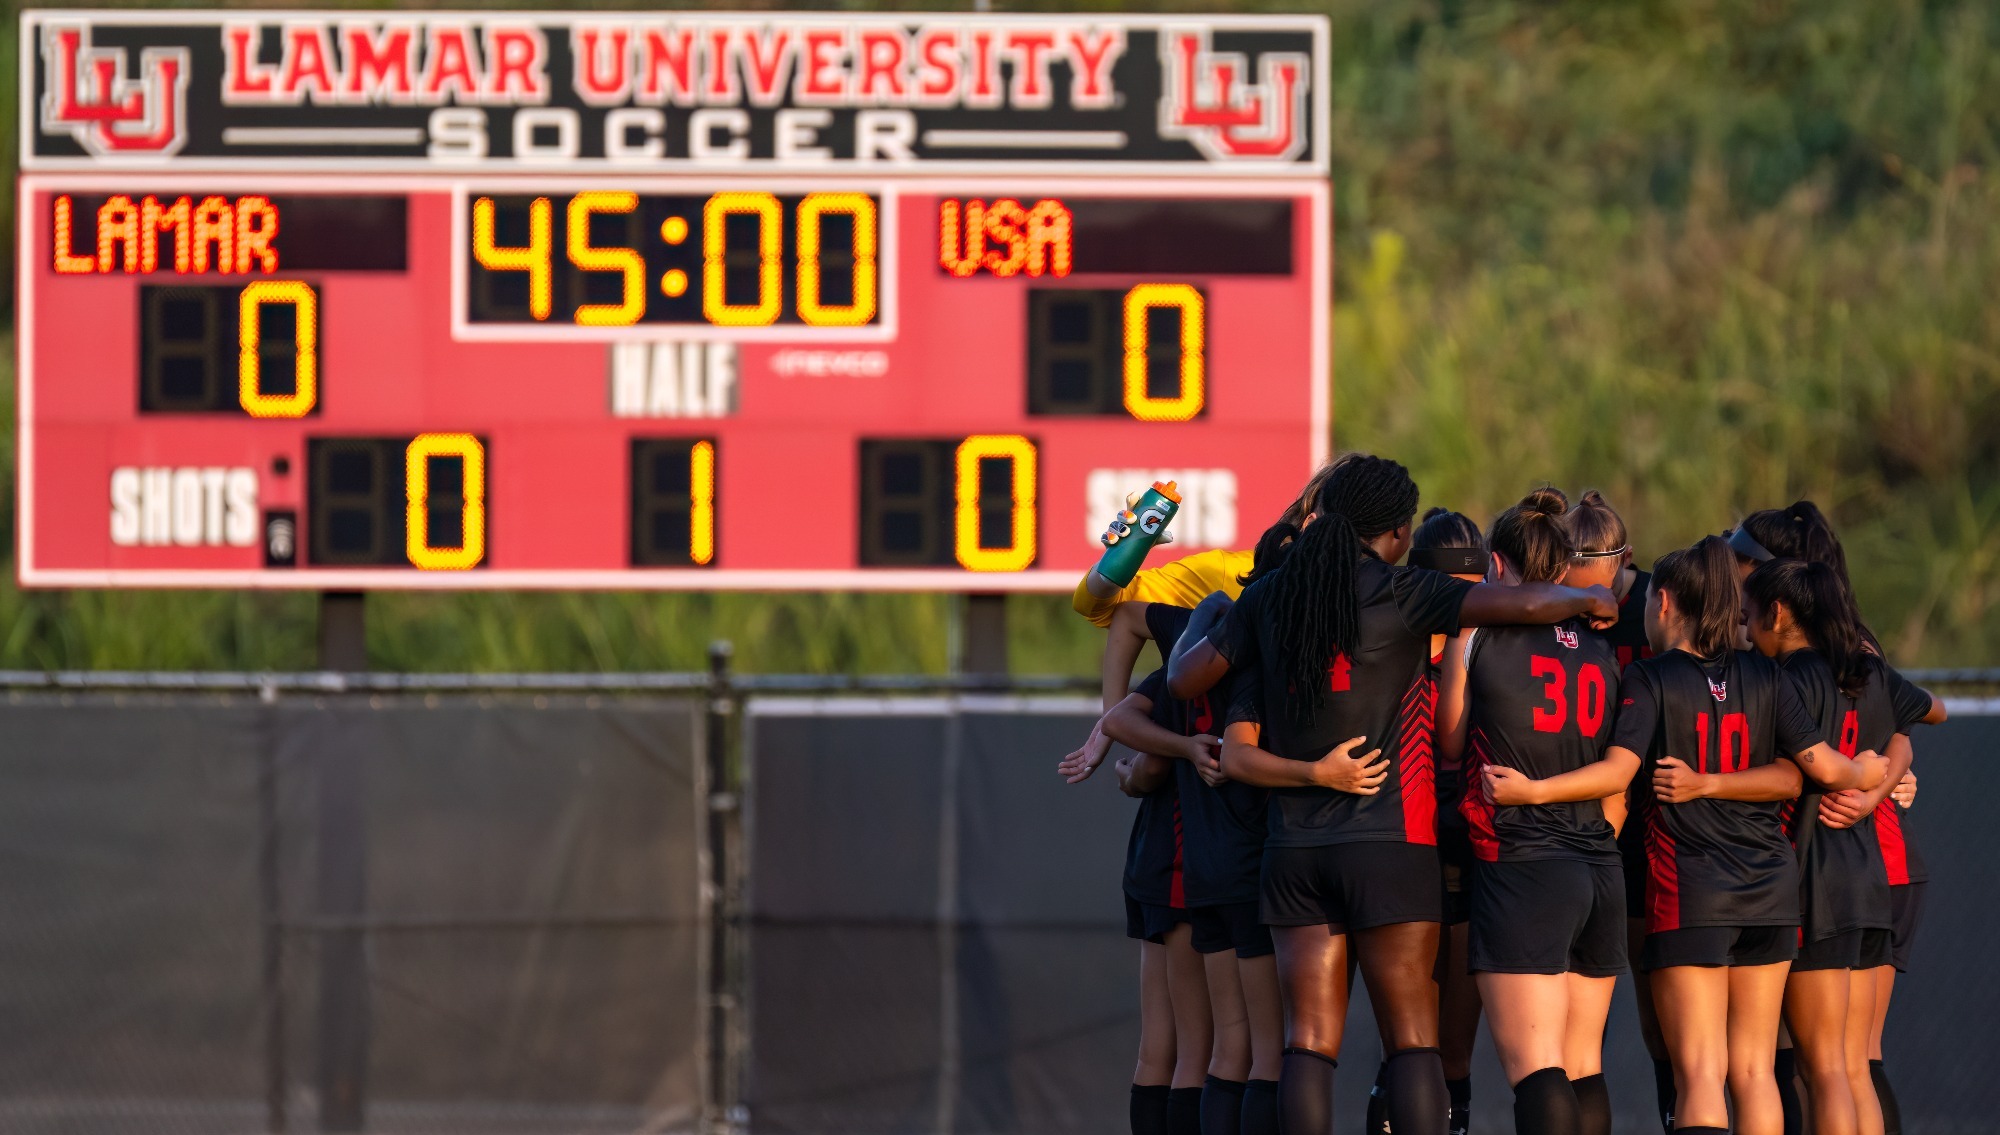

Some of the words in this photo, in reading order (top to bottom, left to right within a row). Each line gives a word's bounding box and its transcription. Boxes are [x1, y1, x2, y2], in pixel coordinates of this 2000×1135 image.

[44, 24, 189, 156] LU
[224, 26, 547, 102] LAMAR
[574, 27, 1124, 105] UNIVERSITY
[1160, 29, 1307, 160] LU
[428, 108, 918, 160] SOCCER
[53, 195, 280, 274] LAMAR
[472, 191, 877, 327] 45:00
[939, 198, 1073, 278] USA
[239, 280, 317, 418] 0
[612, 342, 737, 418] HALF
[1123, 284, 1205, 422] 0
[110, 466, 259, 547] SHOTS
[405, 432, 485, 571] 0
[690, 440, 714, 565] 1
[955, 434, 1037, 572] 0
[1531, 654, 1606, 738] 30
[1696, 711, 1750, 774] 10
